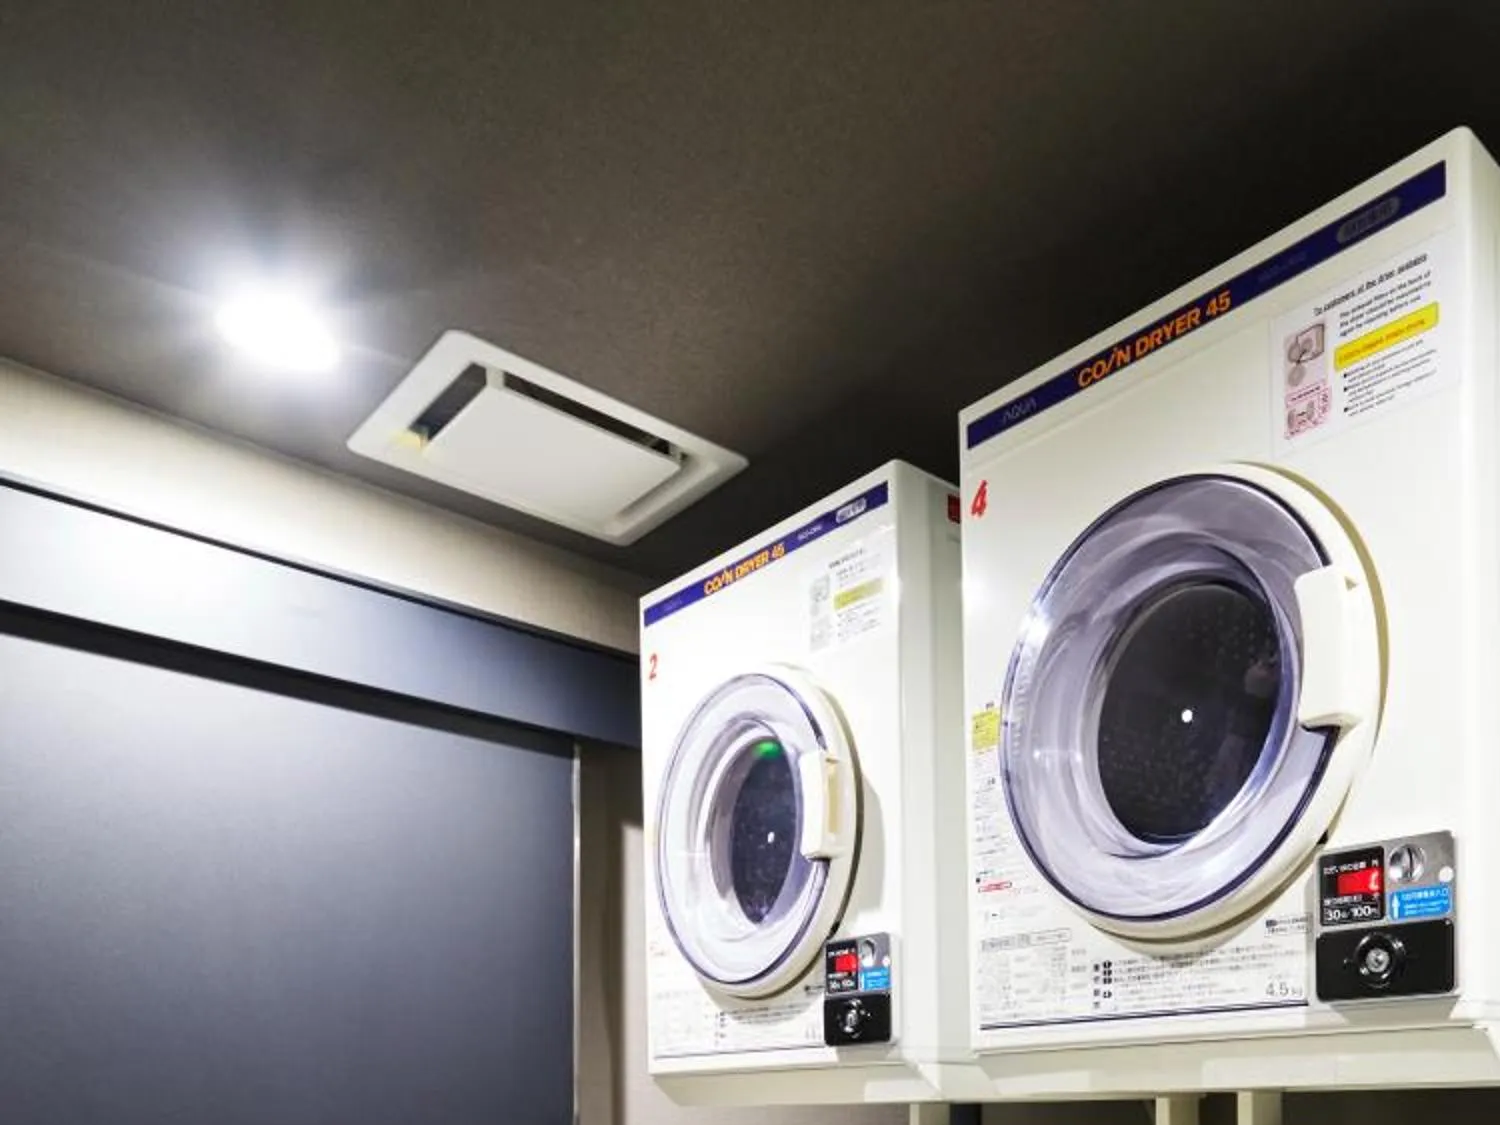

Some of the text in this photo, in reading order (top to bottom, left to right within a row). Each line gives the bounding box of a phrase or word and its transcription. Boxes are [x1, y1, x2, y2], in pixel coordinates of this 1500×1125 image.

[1135, 309, 1202, 361] DRYER
[1205, 290, 1232, 318] 45
[971, 480, 987, 517] 4
[648, 653, 658, 681] 2
[1266, 982, 1290, 997] 4.5
